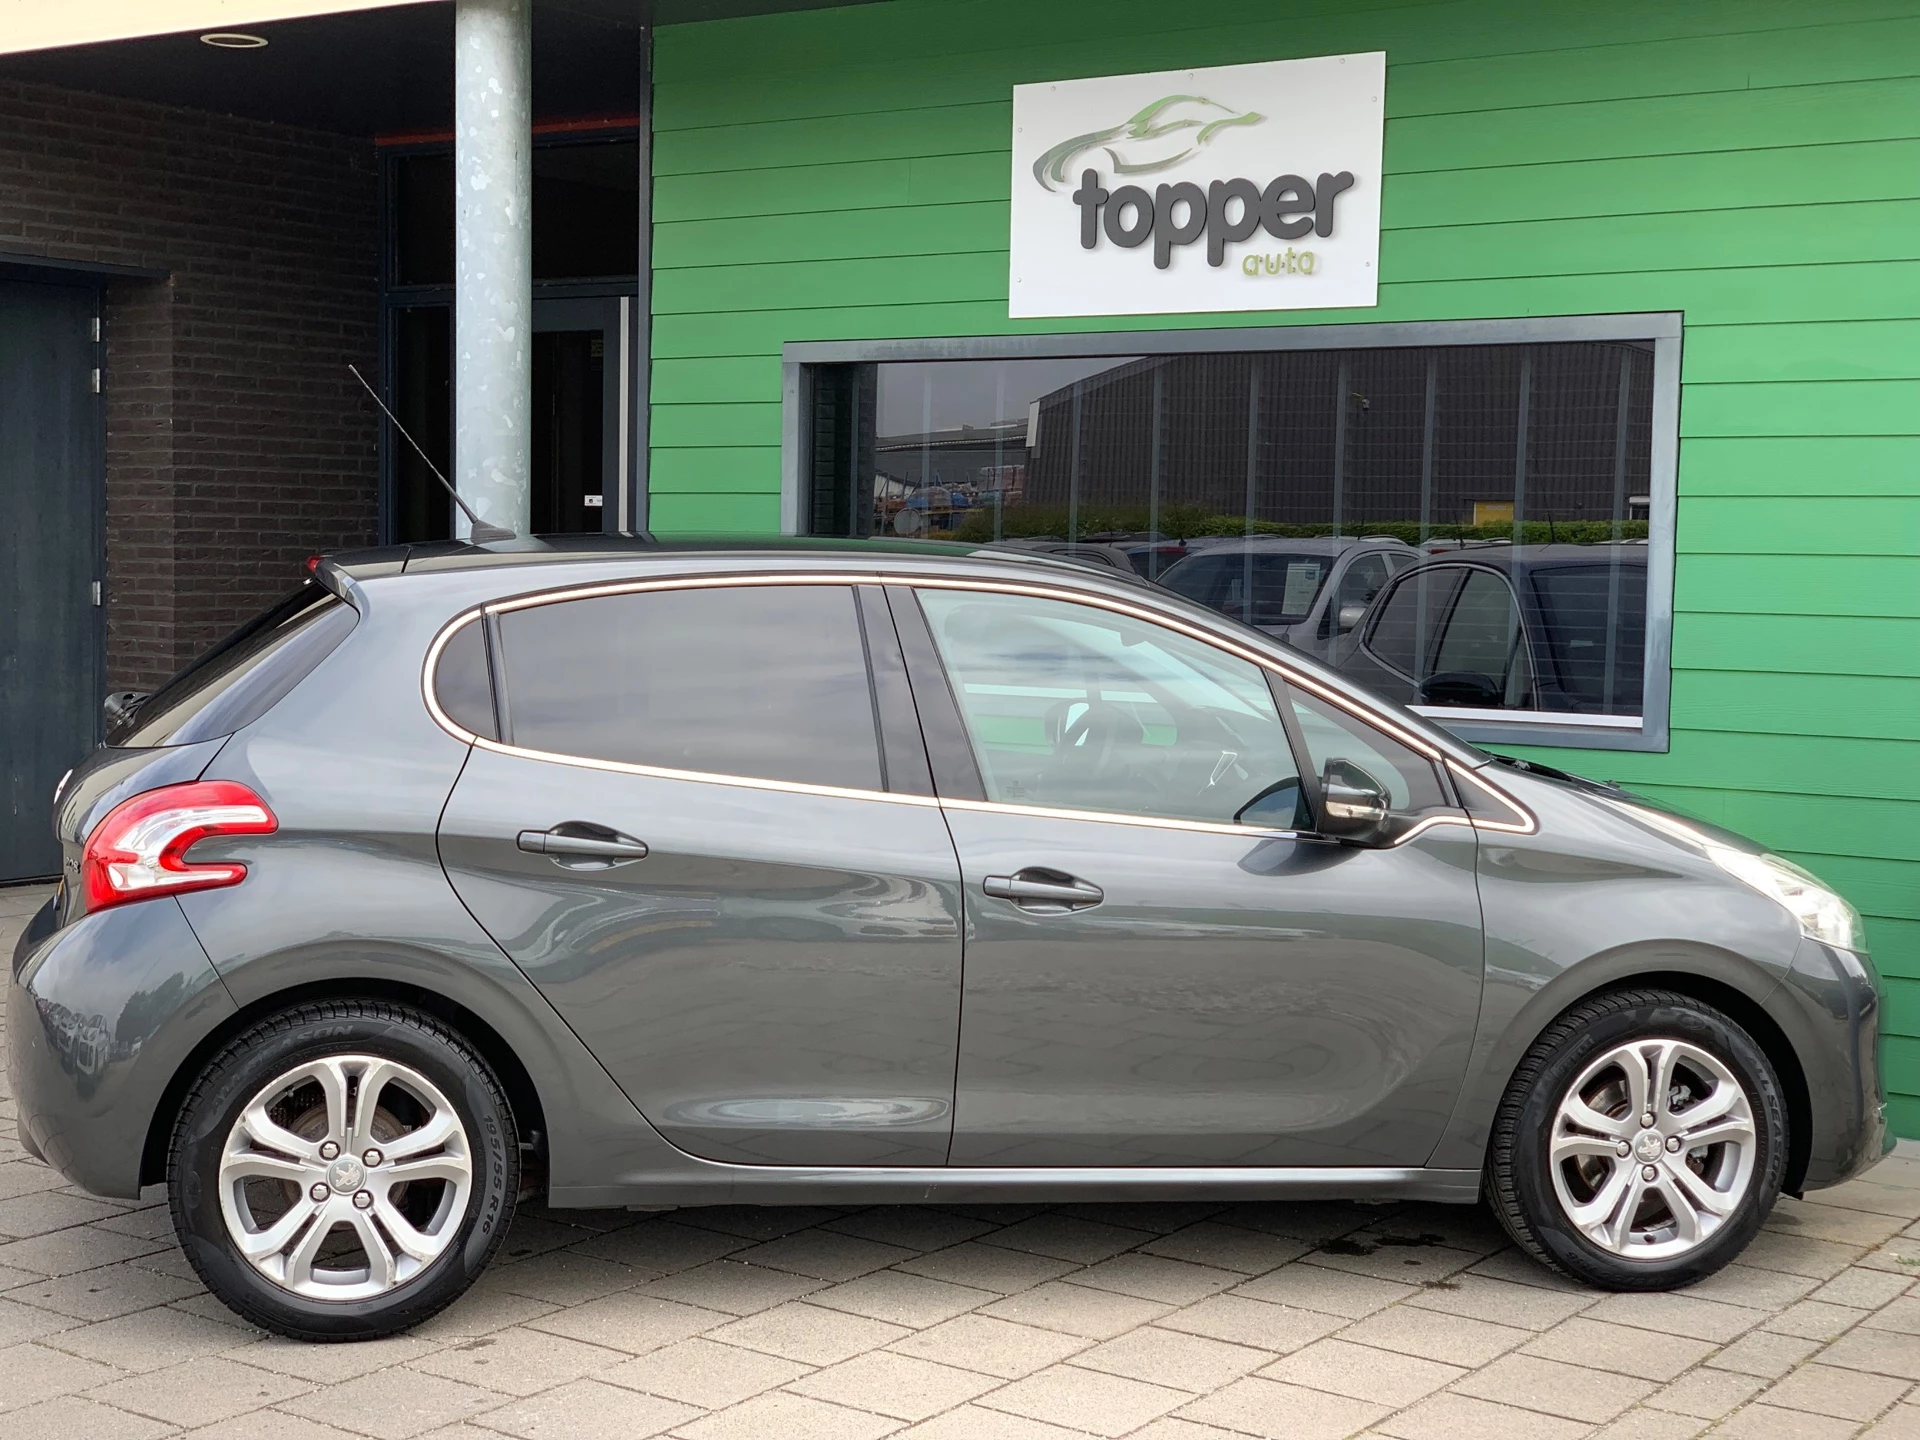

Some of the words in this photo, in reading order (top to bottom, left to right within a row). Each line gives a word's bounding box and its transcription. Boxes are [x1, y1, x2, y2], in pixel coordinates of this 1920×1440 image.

[1073, 168, 1354, 270] topper
[1242, 247, 1316, 276] auto
[482, 1114, 503, 1191] 195/55
[1767, 1095, 1783, 1189] SEASON
